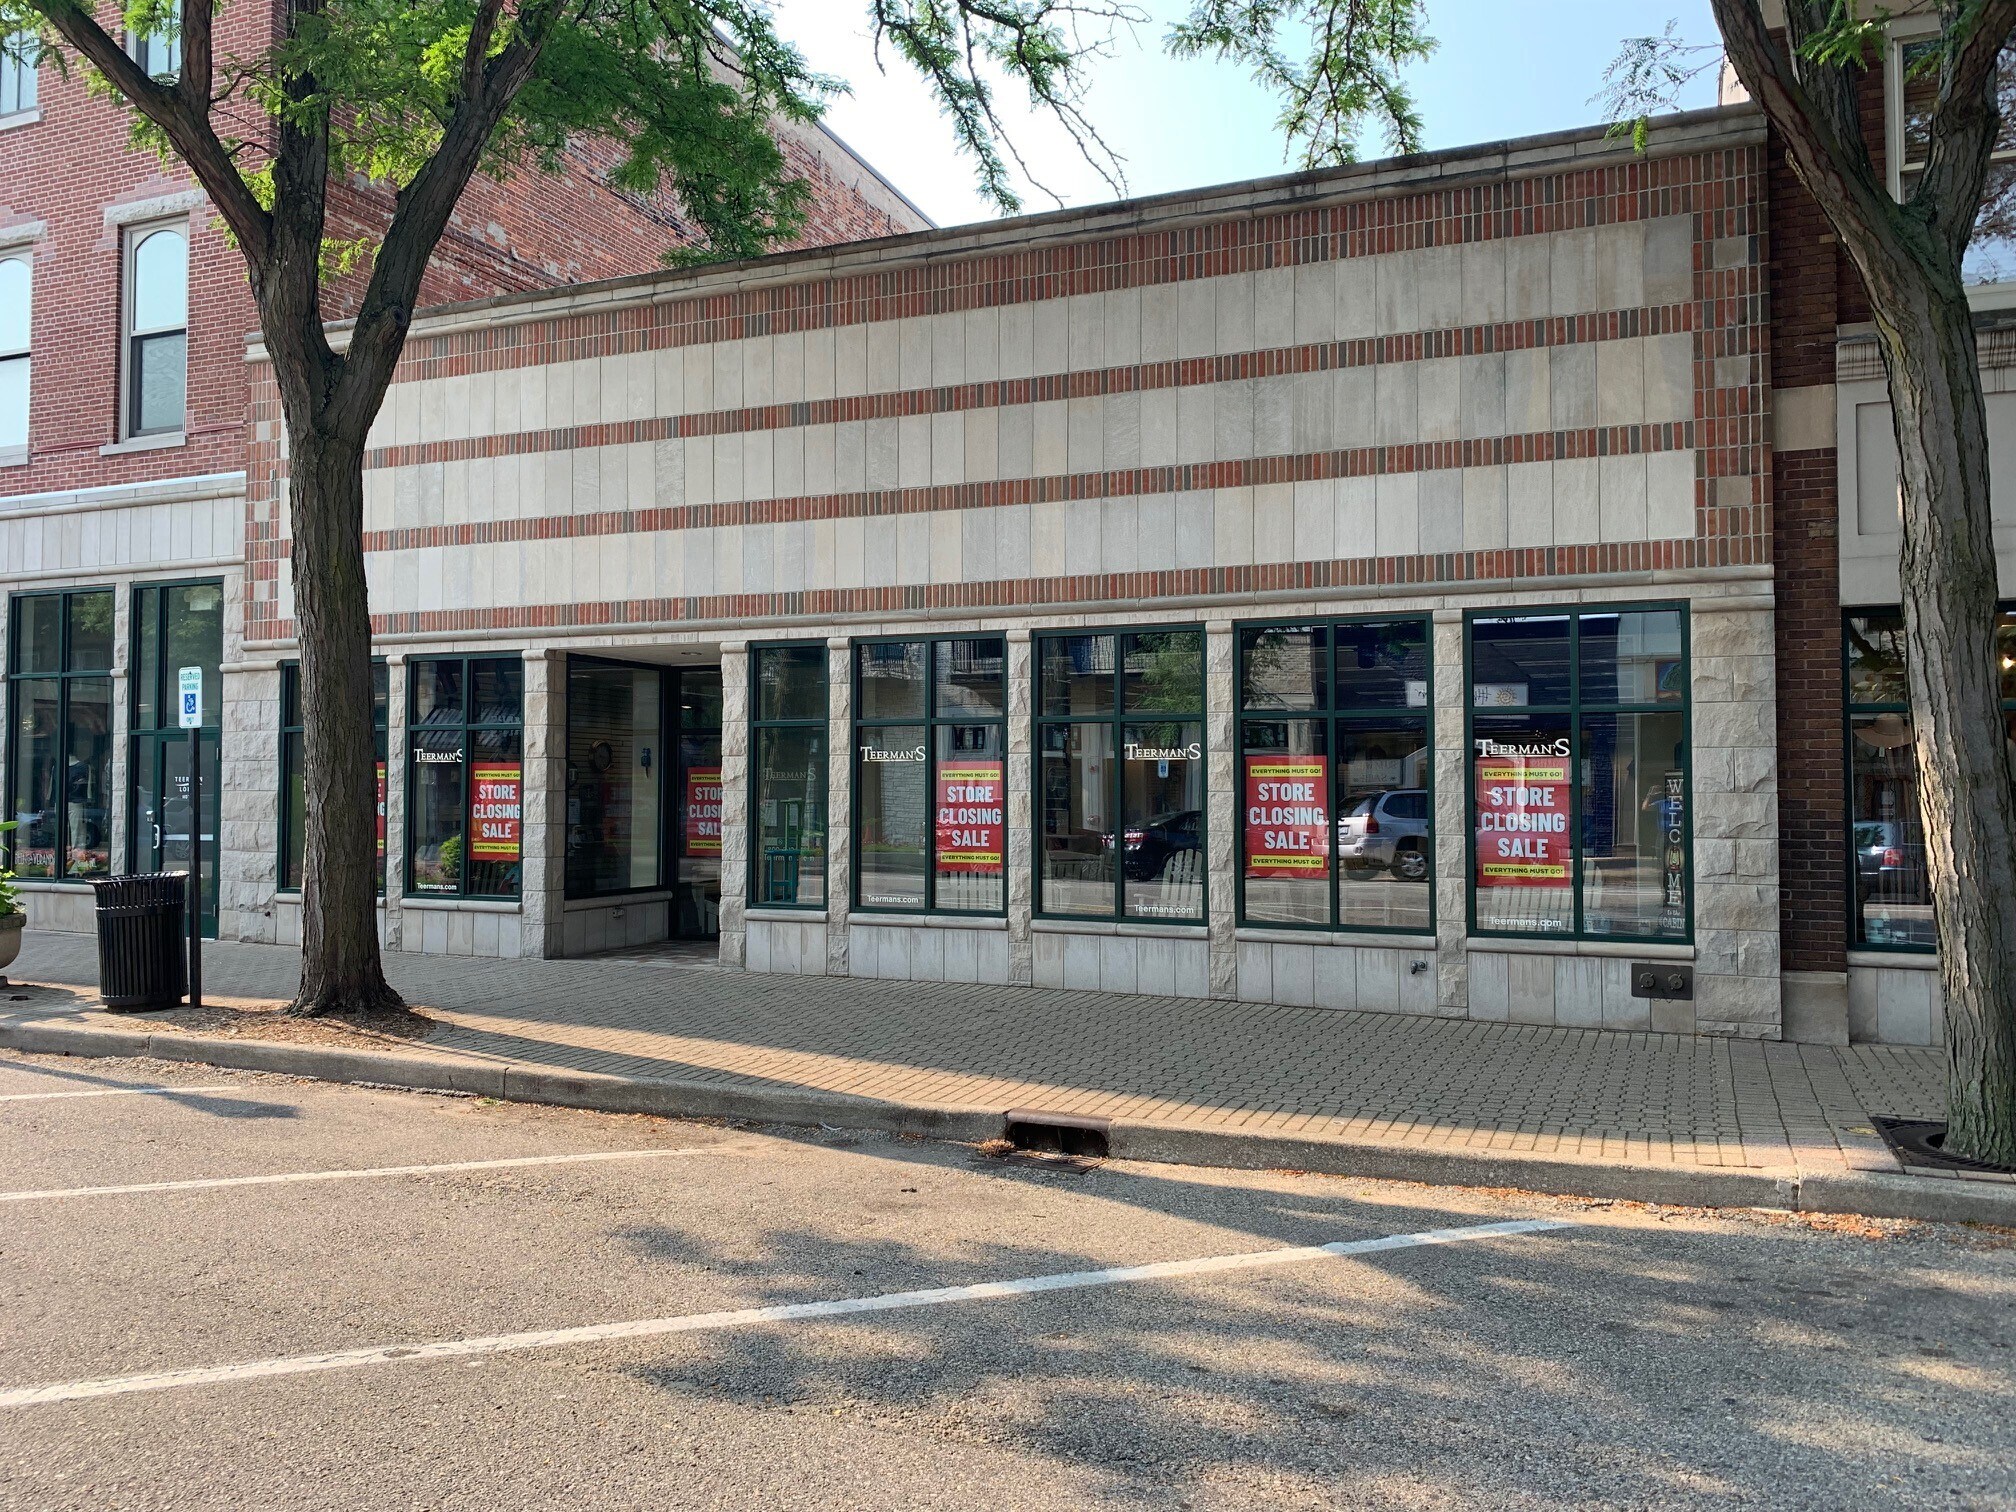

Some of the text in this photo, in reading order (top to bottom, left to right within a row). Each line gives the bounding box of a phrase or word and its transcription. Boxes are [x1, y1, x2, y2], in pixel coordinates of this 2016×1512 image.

[414, 749, 462, 762] TEERMAN'S
[861, 746, 925, 762] TEERMAN'S
[1124, 743, 1201, 760] TEERMAN'S
[1475, 738, 1570, 757] TEERMAN'S
[479, 785, 516, 800] STORE
[695, 787, 722, 800] STOR
[947, 786, 994, 802] STORE
[1258, 783, 1314, 801] STORE
[1490, 787, 1554, 806] STORE
[473, 804, 520, 819] CLOSING
[690, 804, 722, 818] CLOSI
[940, 808, 1001, 825] CLOSING
[1250, 807, 1324, 825] CLOSING
[698, 822, 722, 835] SAL
[1481, 812, 1566, 832] CLOSING
[482, 823, 512, 838] SALE
[952, 830, 990, 846] SALE
[1264, 831, 1310, 849] SALE
[1498, 838, 1548, 858] SALE
[867, 895, 918, 903] Teermans.com
[1135, 905, 1194, 913] Teermans.com
[1490, 916, 1562, 926] Teermans.com
